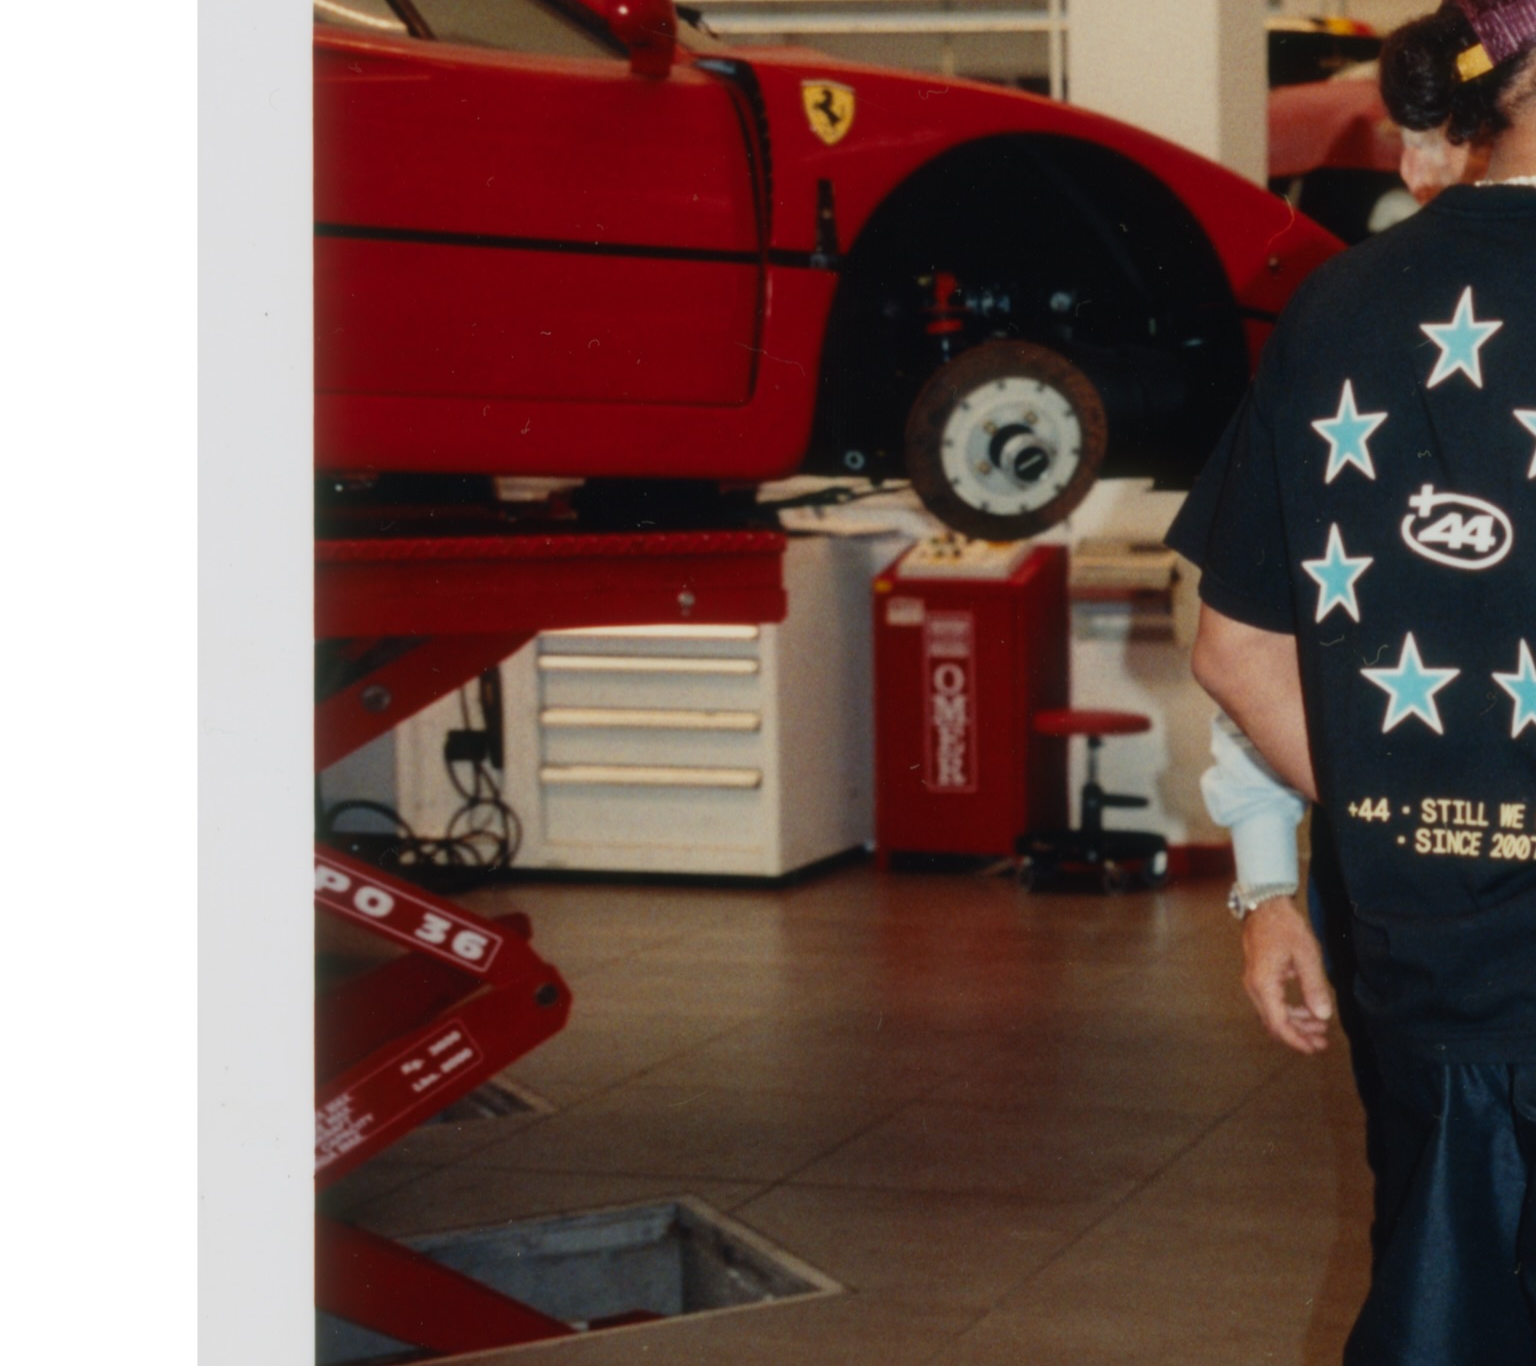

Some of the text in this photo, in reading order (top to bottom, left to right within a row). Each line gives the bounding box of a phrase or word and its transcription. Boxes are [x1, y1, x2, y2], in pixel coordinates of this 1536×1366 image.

[932, 662, 967, 788] OMER
[1420, 798, 1490, 827] STILL
[1500, 803, 1526, 829] WE
[1414, 828, 1483, 857] SINCE
[414, 912, 489, 961] 36
